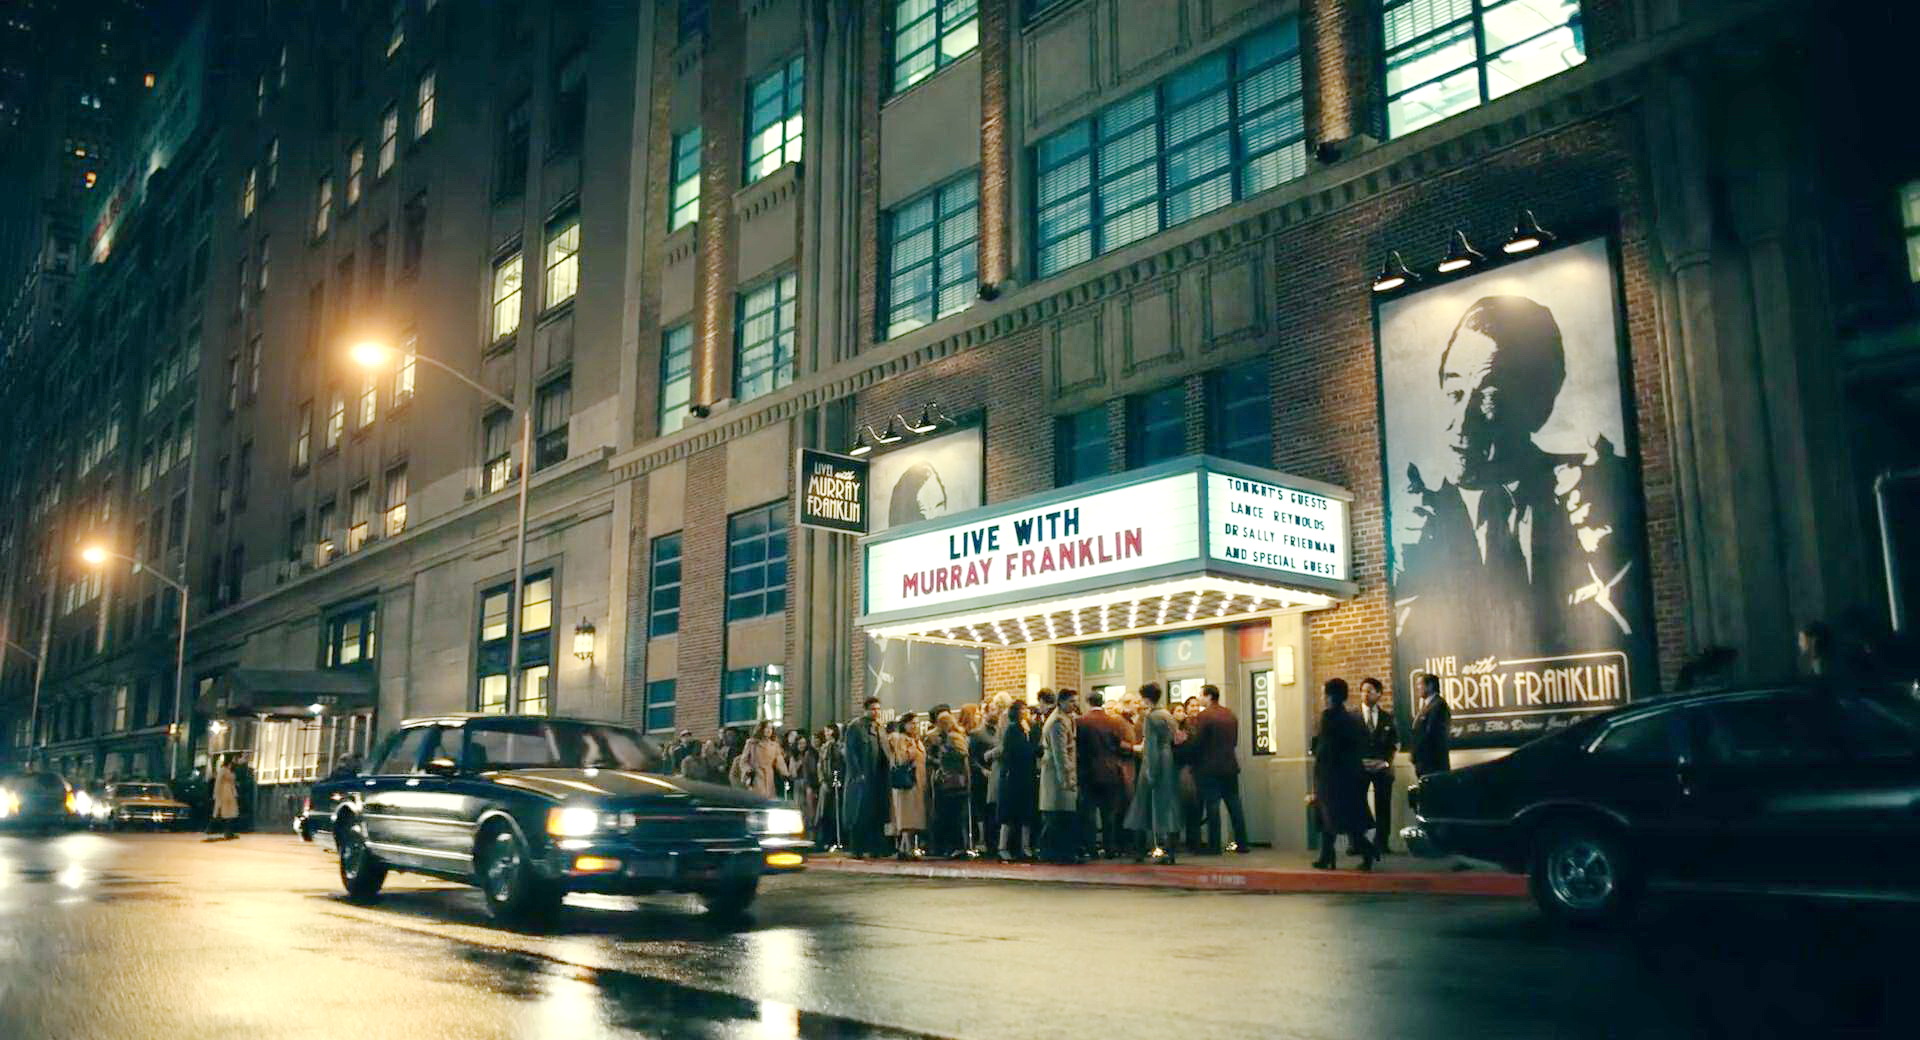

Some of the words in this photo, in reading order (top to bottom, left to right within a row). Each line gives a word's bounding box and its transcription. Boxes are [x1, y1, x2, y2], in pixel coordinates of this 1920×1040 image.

[808, 475, 860, 502] MURRAY
[1291, 492, 1328, 510] GUESTS
[807, 495, 860, 523] FRANKLIN
[1231, 501, 1263, 519] LANCE
[1274, 510, 1325, 531] REYNOLDS
[949, 524, 1001, 561] LIVE
[1013, 506, 1080, 547] WITH
[1225, 523, 1239, 536] DR
[1243, 527, 1275, 543] SALLY
[1283, 534, 1336, 554] FRIEDMAN
[902, 557, 993, 599] MURRAY
[1005, 527, 1143, 580] FRANKLIN
[1225, 546, 1247, 560] AND
[1253, 551, 1296, 569] SPECIAL
[1303, 560, 1336, 576] GUEST
[1101, 647, 1117, 670] N
[1177, 639, 1193, 661] C
[1425, 655, 1457, 676] LIVE!
[1461, 655, 1498, 675] with
[1438, 671, 1508, 711] URRAY
[1513, 664, 1620, 706] FRANKLIN
[1255, 676, 1269, 748] STUDIO
